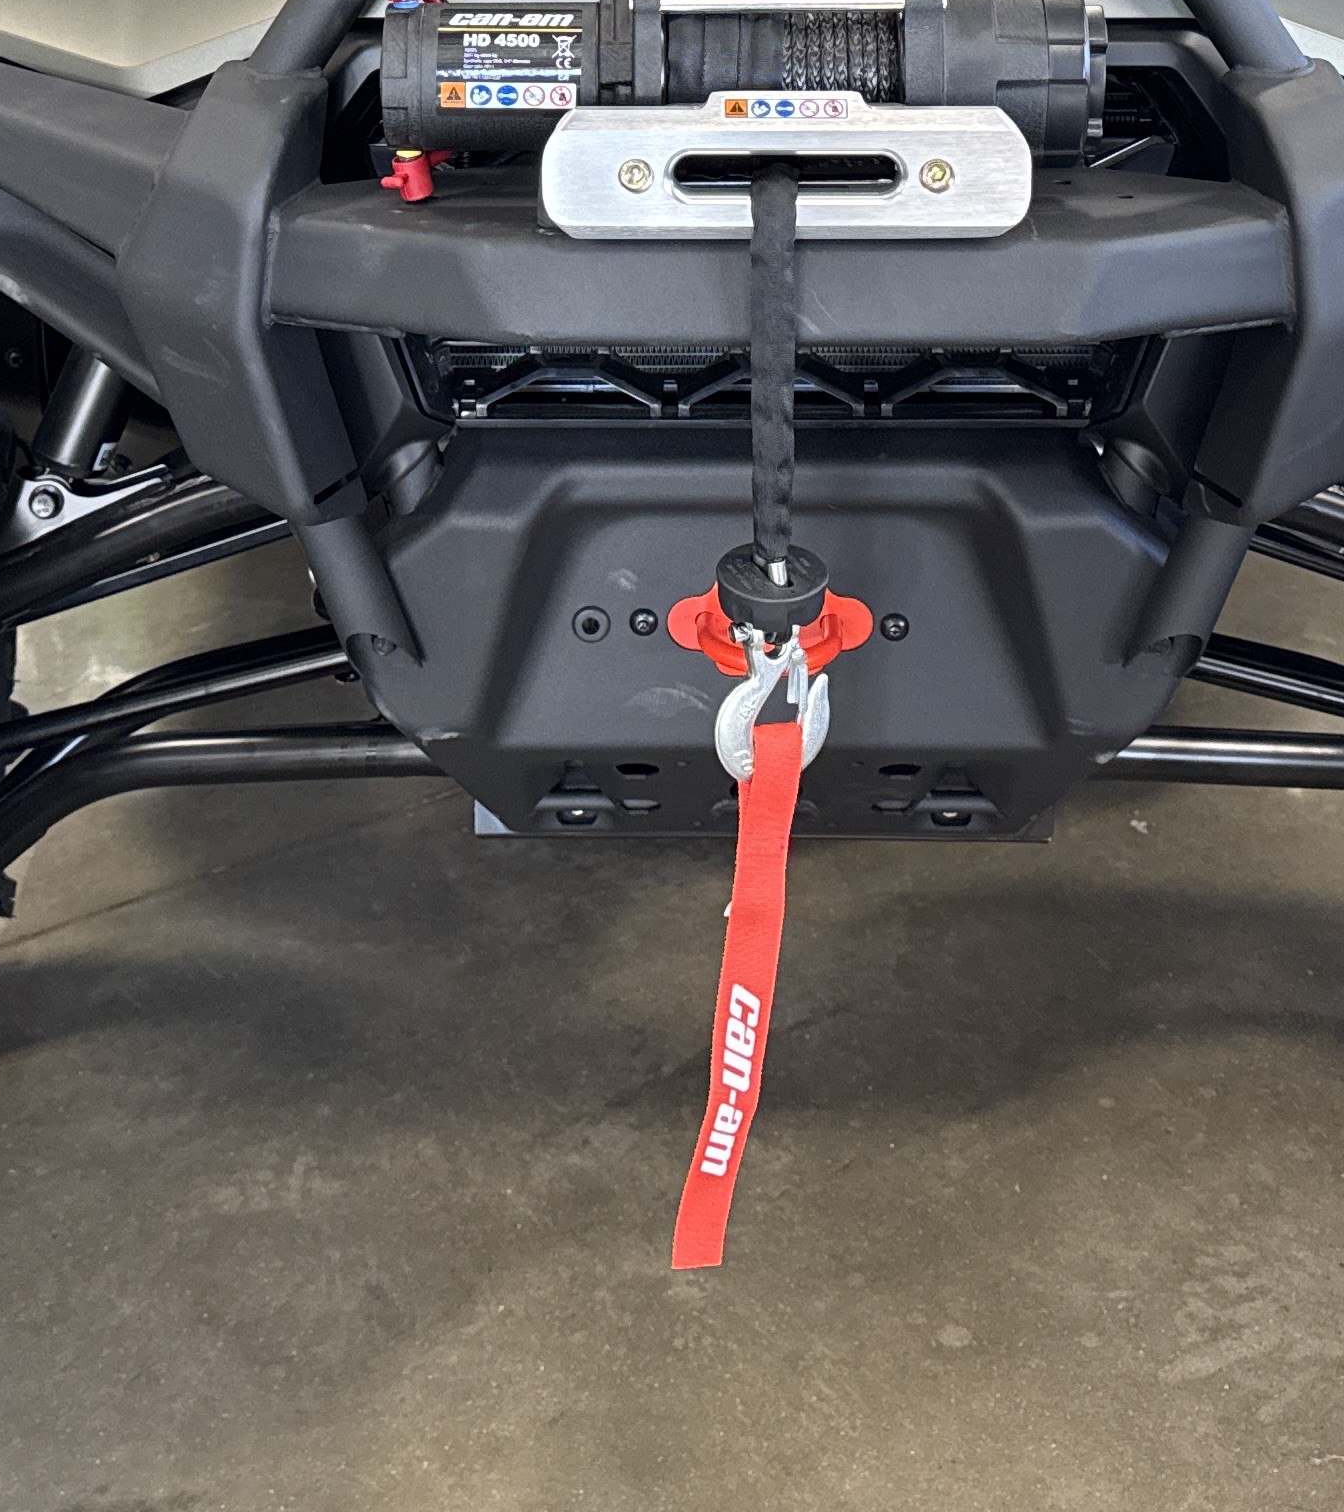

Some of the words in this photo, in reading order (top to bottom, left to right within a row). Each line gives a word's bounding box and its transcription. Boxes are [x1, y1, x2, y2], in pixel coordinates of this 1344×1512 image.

[448, 13, 575, 27] can-am
[463, 33, 491, 47] HD
[494, 33, 541, 47] 4500
[700, 983, 761, 1177] can-am
